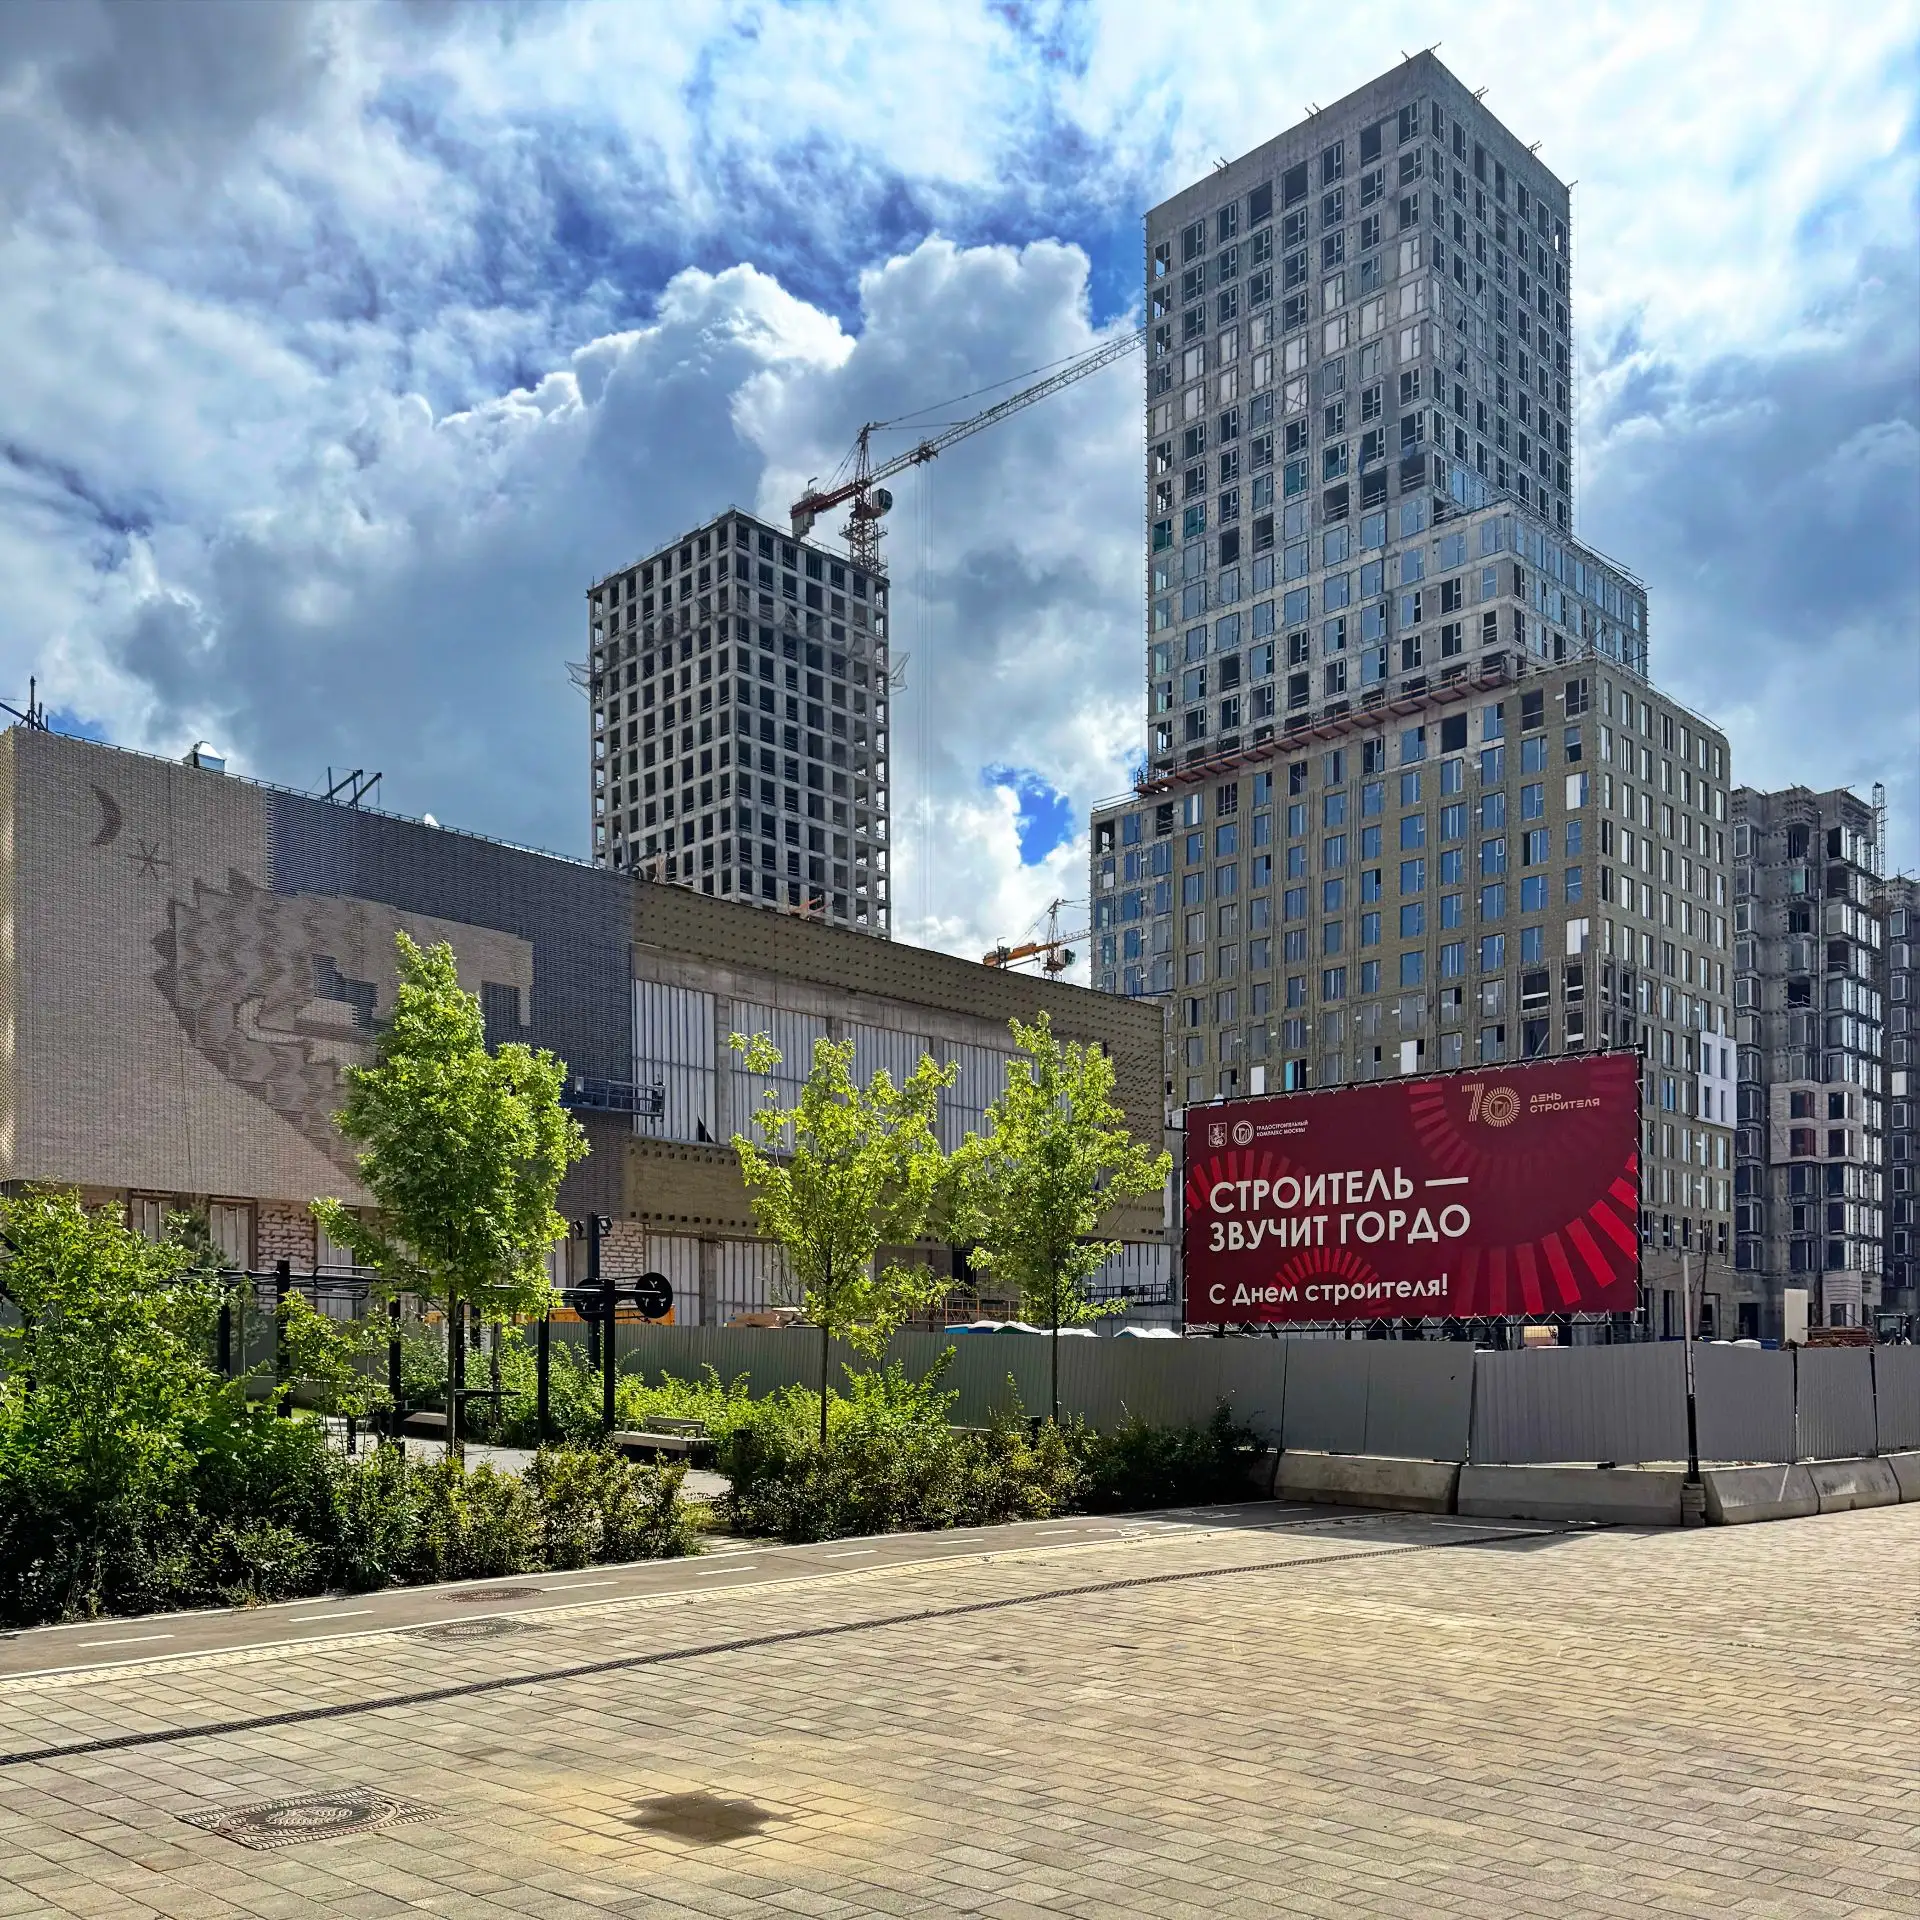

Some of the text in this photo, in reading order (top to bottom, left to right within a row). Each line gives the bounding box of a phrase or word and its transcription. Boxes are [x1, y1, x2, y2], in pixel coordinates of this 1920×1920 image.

[1529, 1092, 1562, 1103] ДЕНЬ
[1529, 1098, 1601, 1113] СТРОИТЕЛЯ
[1209, 1166, 1414, 1214] СТРОИТЕЛЬ
[1209, 1204, 1471, 1252] ЗВУЧИТ ГОРДО
[1209, 1273, 1448, 1307] С Днем строителя!
